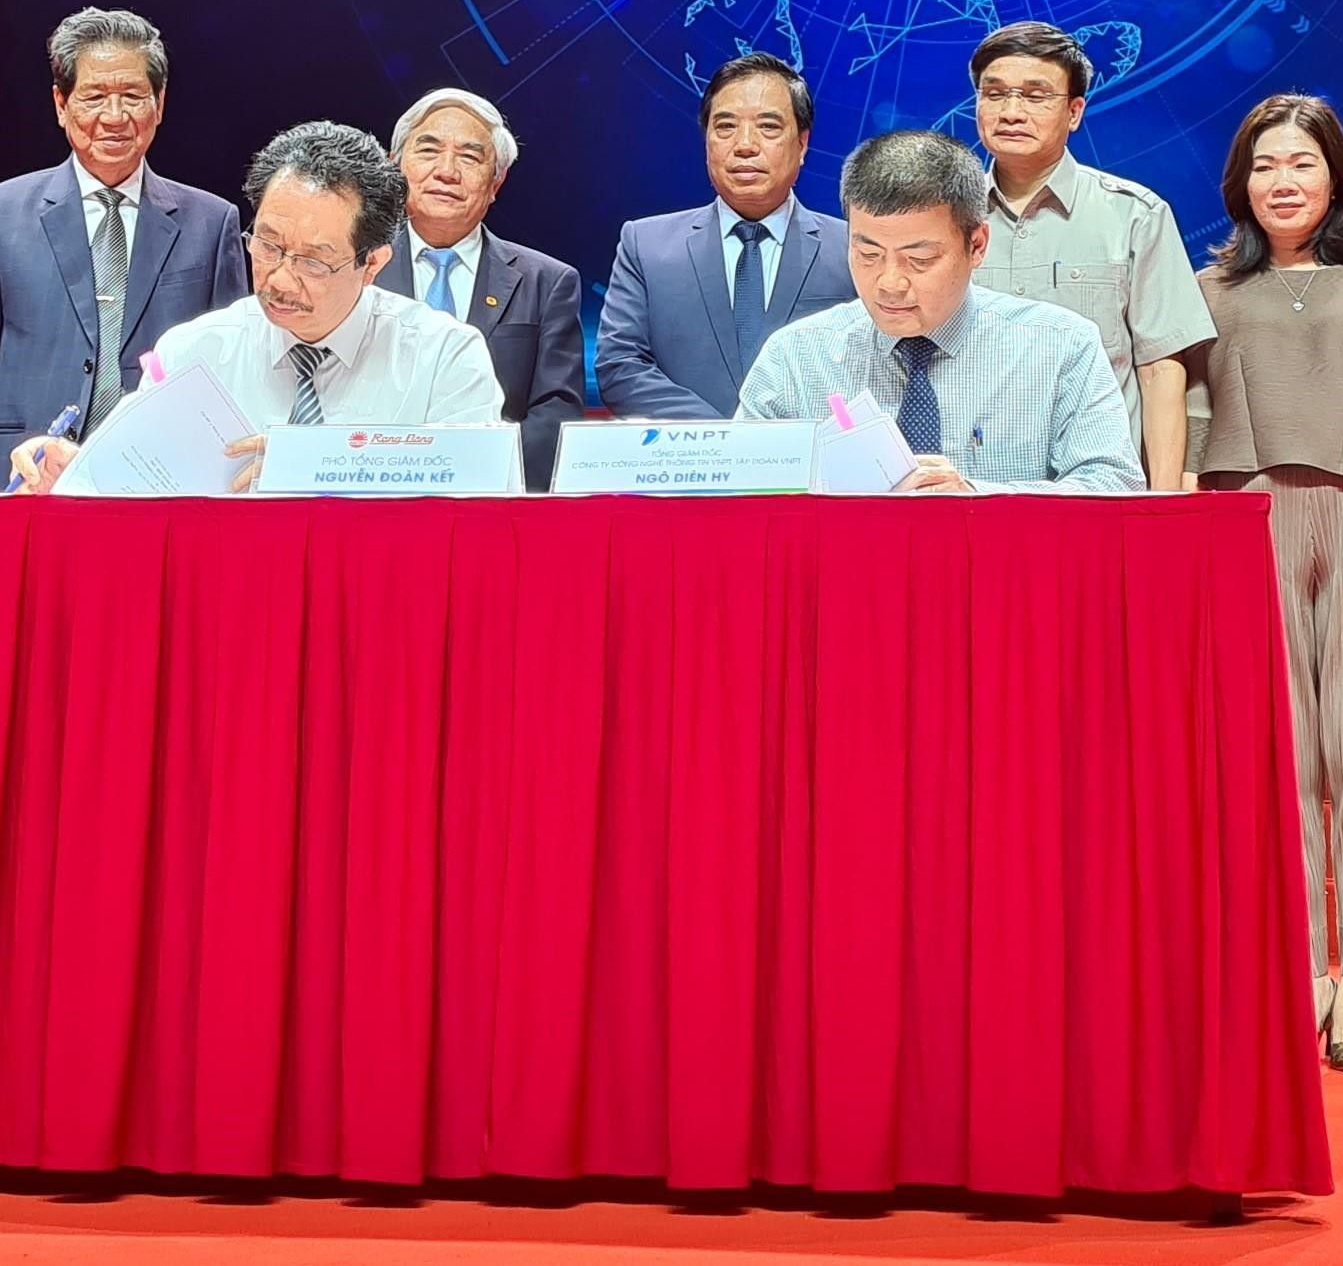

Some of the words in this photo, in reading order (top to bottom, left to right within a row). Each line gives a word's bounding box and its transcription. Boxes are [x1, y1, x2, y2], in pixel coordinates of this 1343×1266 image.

[667, 430, 731, 442] VNPT
[315, 468, 374, 482] NGUYỄN
[380, 470, 424, 482] ĐOÀN
[431, 468, 455, 482] KẾT
[636, 471, 670, 483] NGÔ
[711, 472, 731, 482] HY
